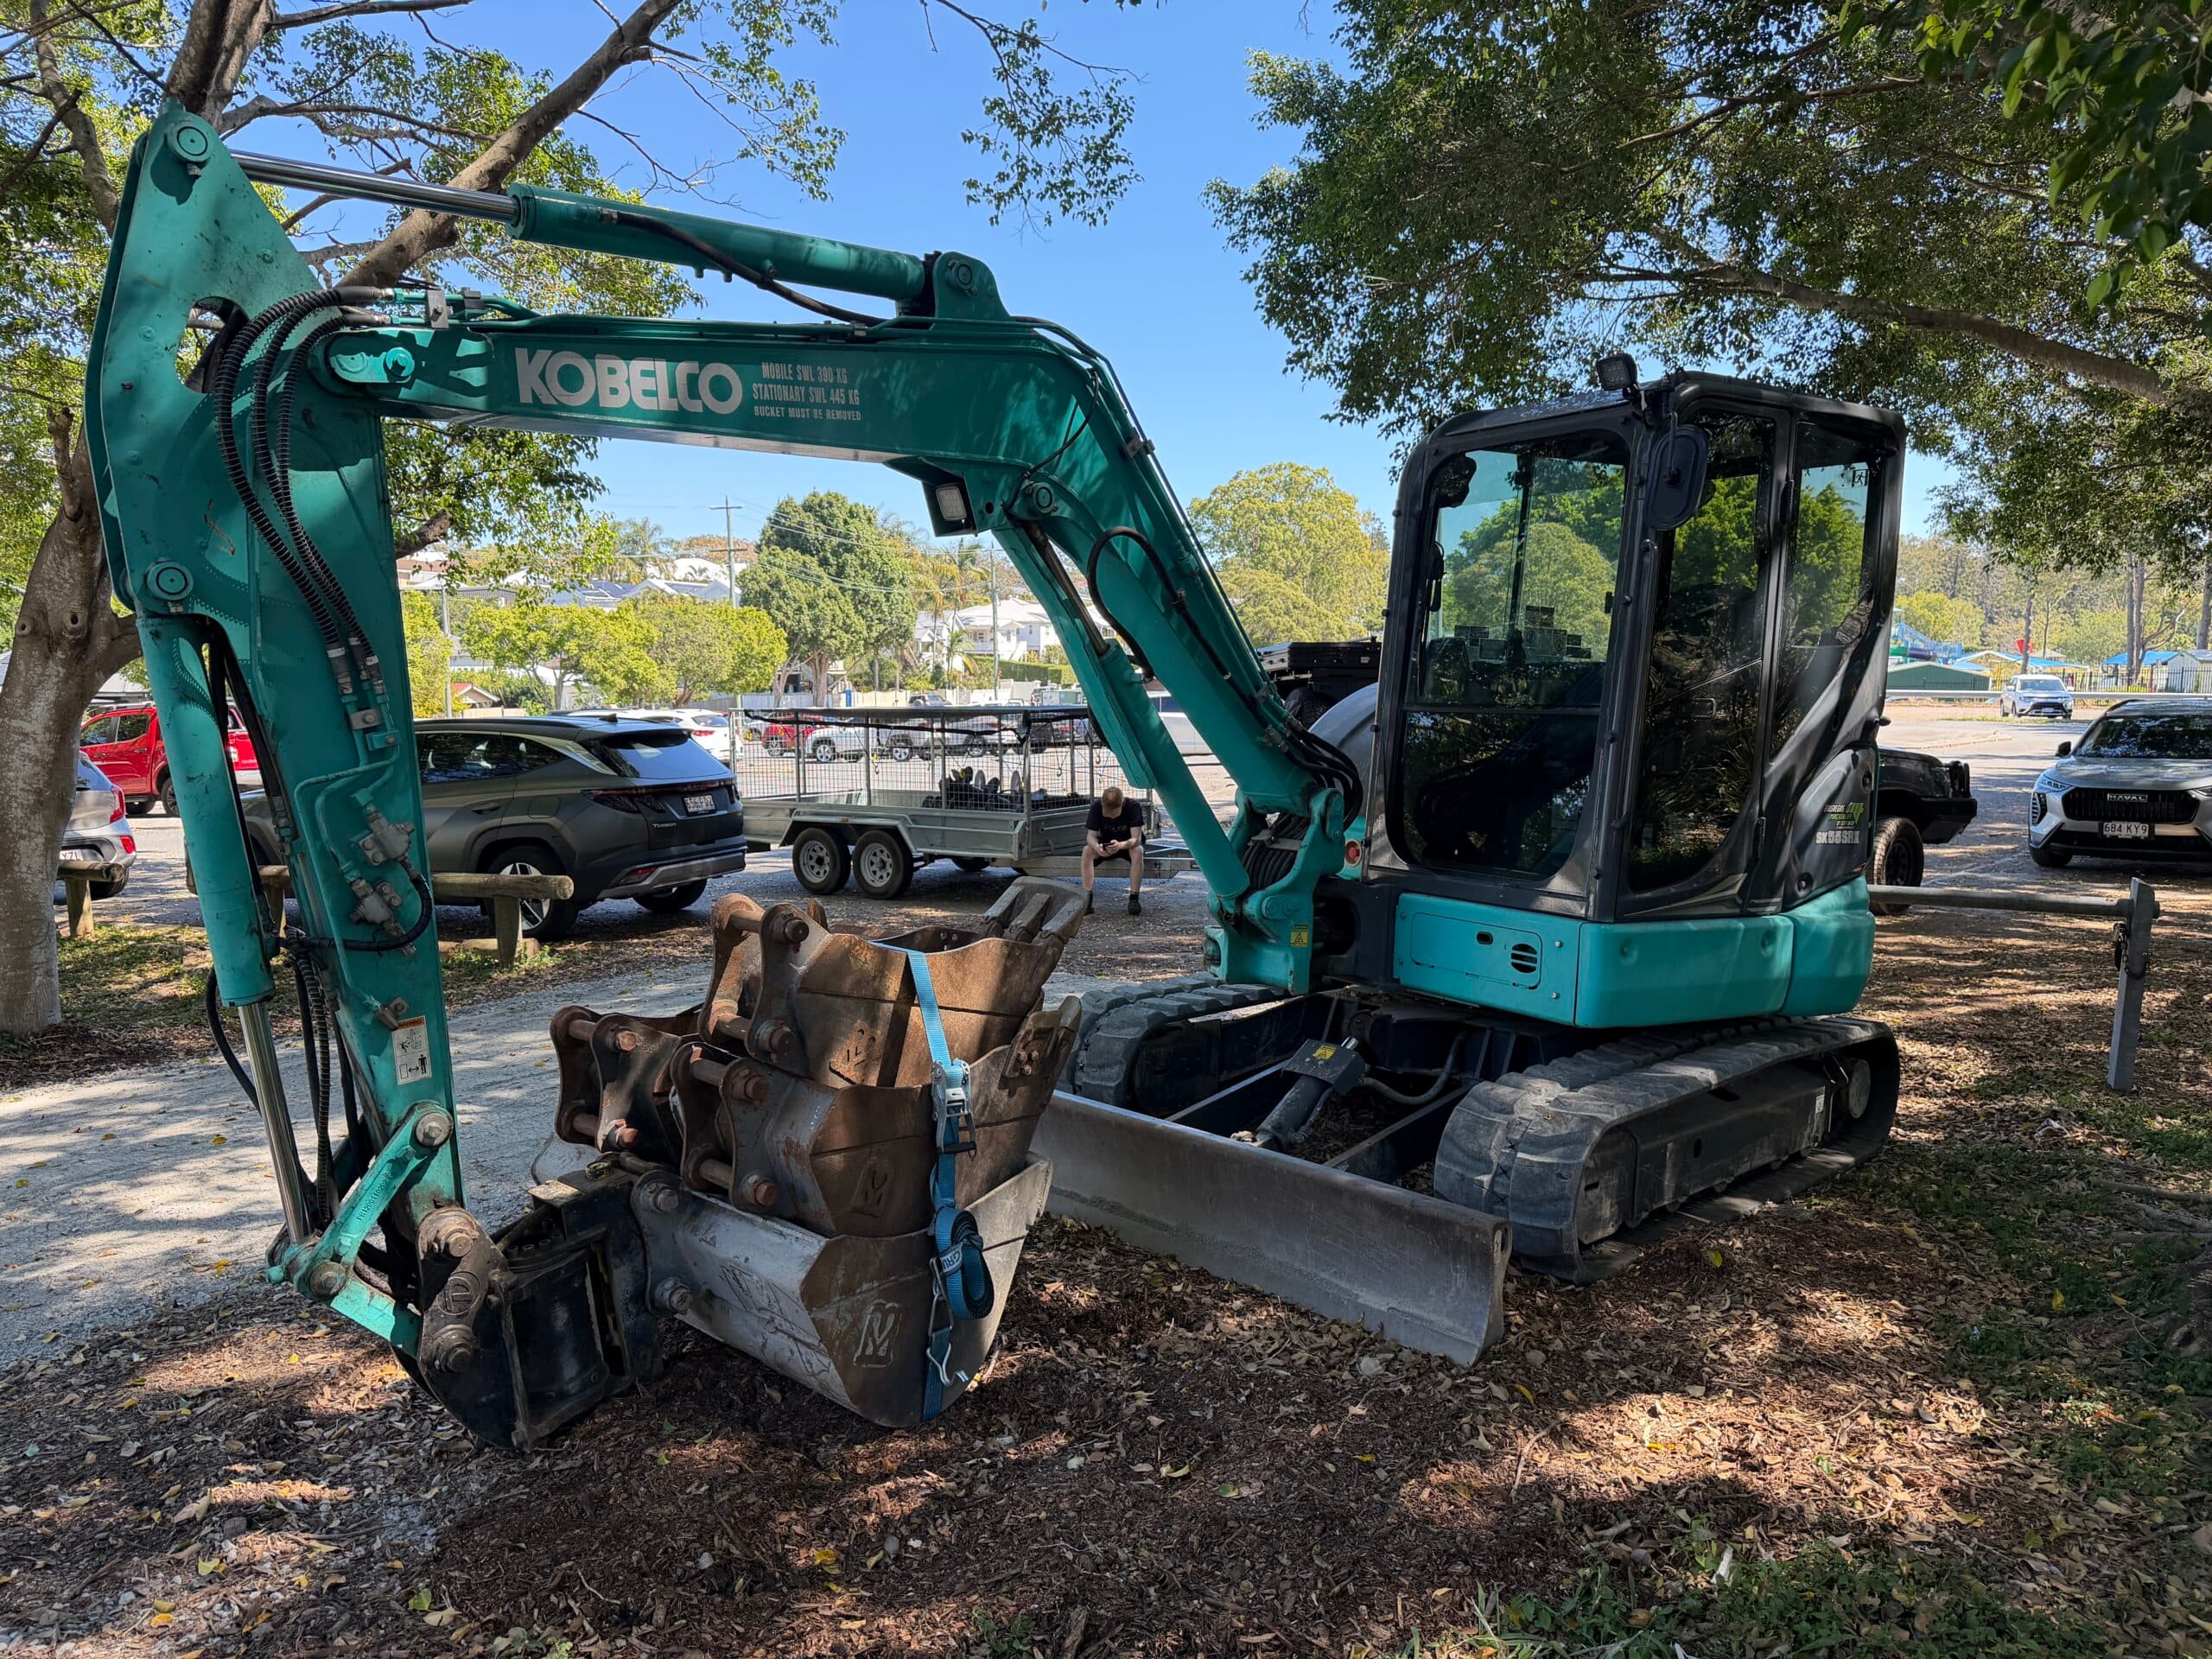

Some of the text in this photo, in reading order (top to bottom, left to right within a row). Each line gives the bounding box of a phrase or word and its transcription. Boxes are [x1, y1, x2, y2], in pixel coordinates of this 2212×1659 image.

[515, 347, 743, 415] KOBELCO
[762, 362, 848, 384] MOBILE SWL 390 KG
[753, 383, 860, 405] STATIONARY SWL 445 KG
[754, 405, 861, 421] BUCKET MUST BE REMOVED
